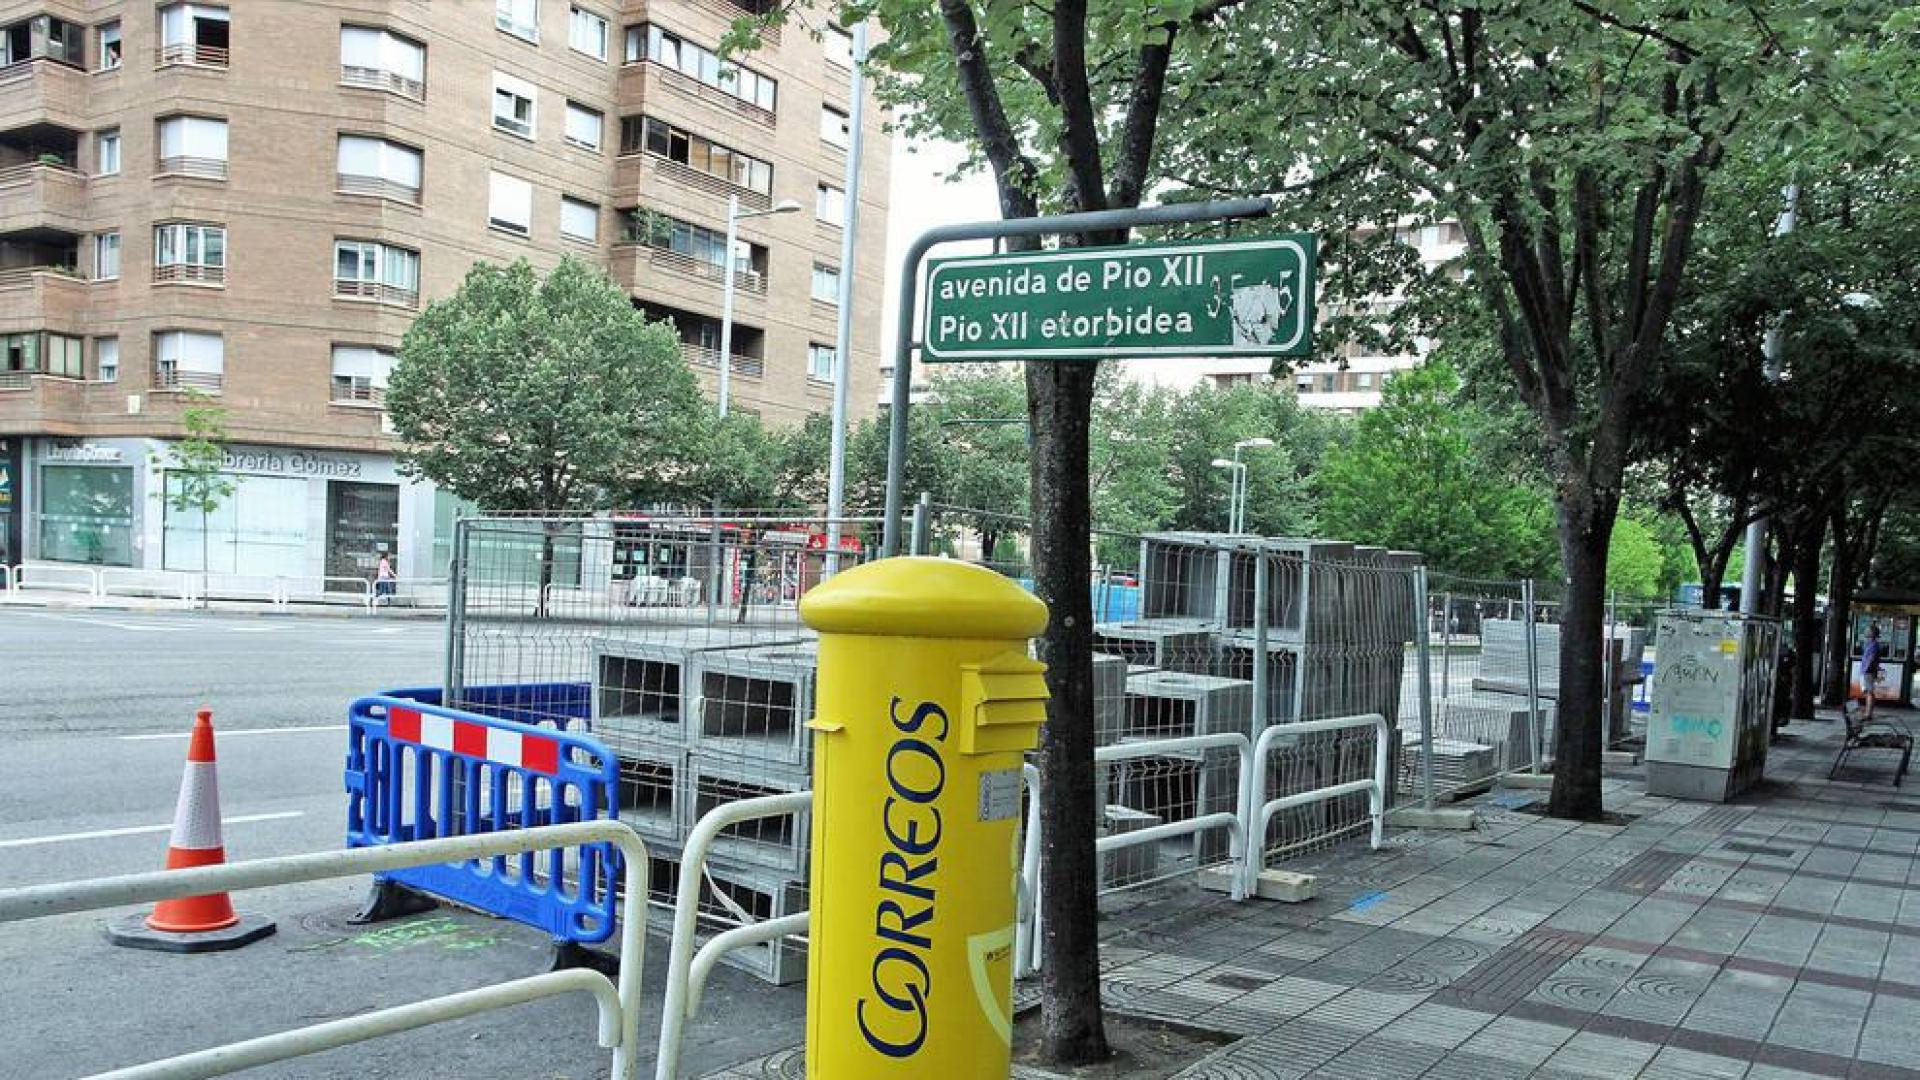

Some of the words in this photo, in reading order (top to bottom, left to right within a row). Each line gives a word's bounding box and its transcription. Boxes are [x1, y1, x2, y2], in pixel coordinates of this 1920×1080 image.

[940, 266, 1046, 299] avenida
[1056, 264, 1091, 292] de
[1102, 260, 1151, 290] Pio
[1160, 254, 1204, 286] XII
[939, 315, 982, 341] Pio
[990, 311, 1028, 340] XII
[1041, 305, 1194, 338] etorbidea
[857, 695, 949, 1059] CORREOS
